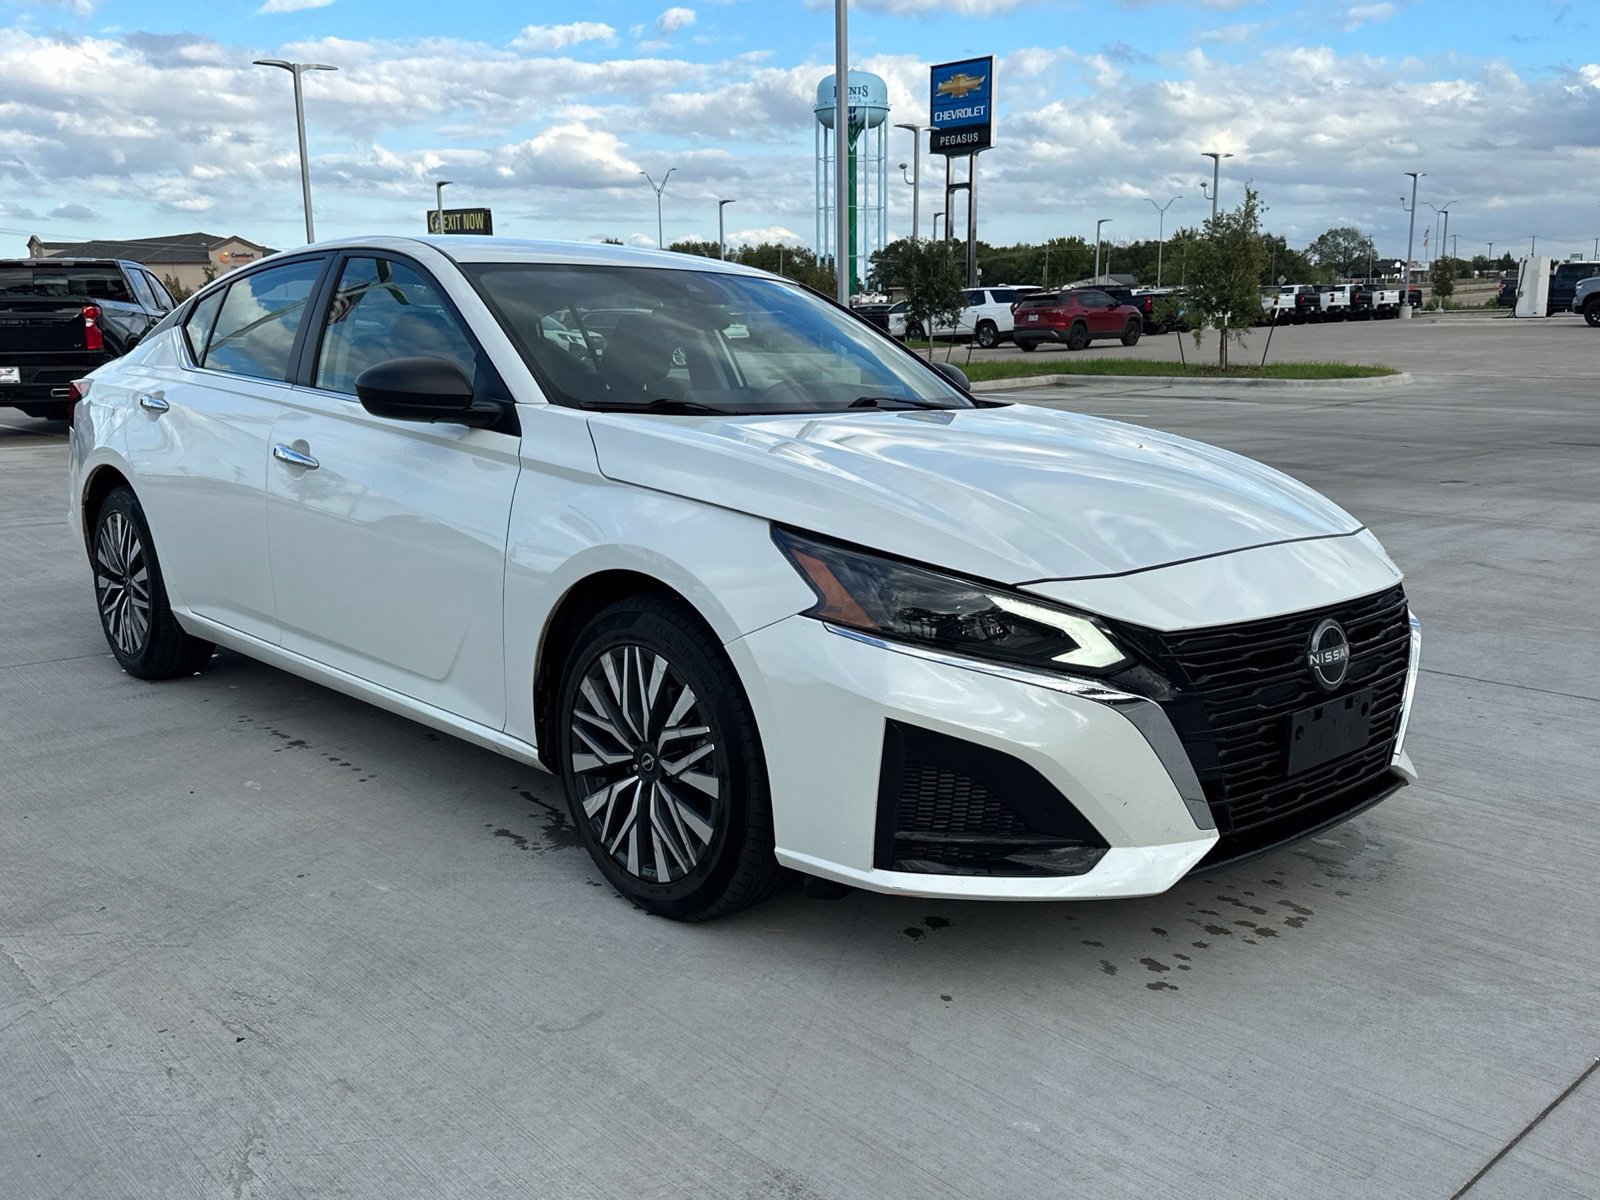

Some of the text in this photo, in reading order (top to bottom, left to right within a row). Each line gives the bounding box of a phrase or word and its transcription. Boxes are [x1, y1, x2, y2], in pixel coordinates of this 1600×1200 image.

[834, 85, 869, 98] NIS
[934, 105, 986, 122] CHEVROLET
[940, 132, 979, 146] PEGASUS
[443, 212, 484, 231] EXIT NOW
